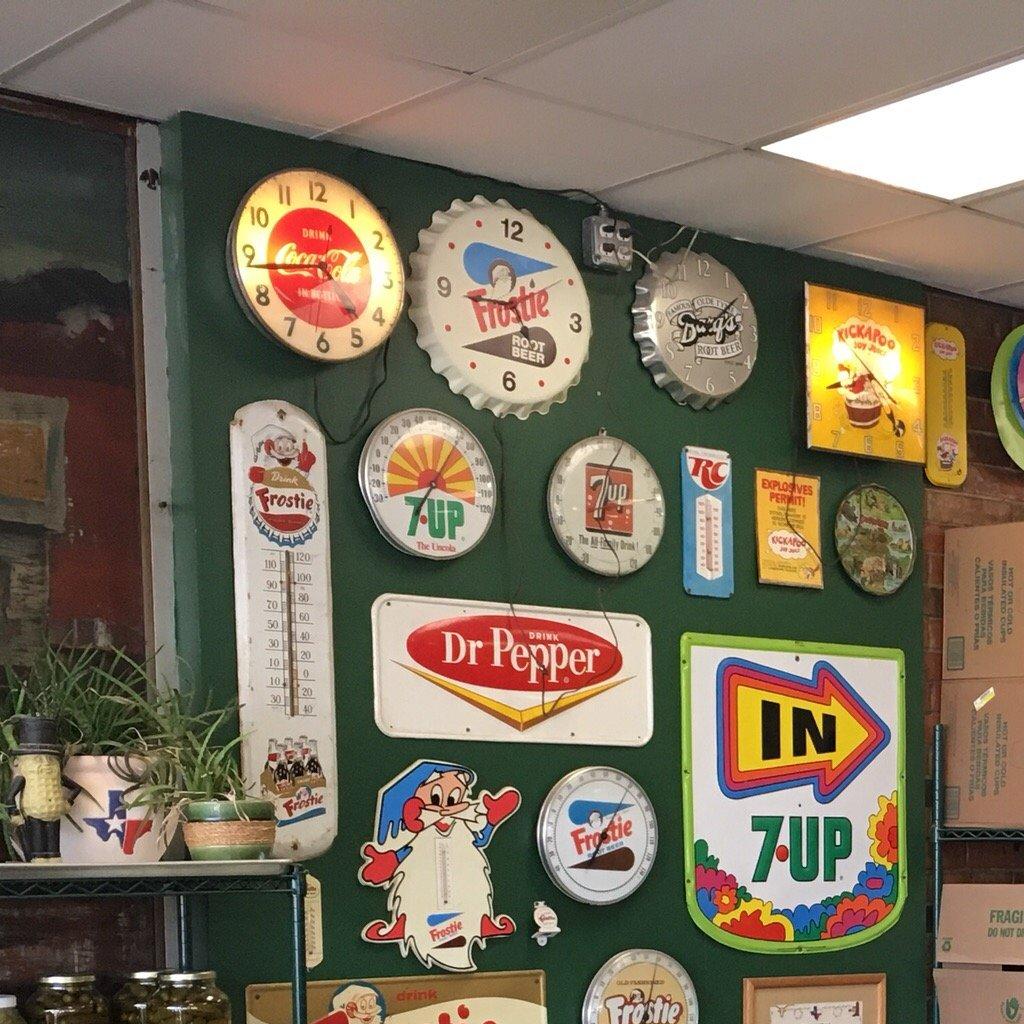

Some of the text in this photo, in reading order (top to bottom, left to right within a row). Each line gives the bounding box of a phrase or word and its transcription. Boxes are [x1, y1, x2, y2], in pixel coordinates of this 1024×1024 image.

[279, 185, 290, 206] 11
[309, 180, 327, 203] 12
[251, 207, 268, 227] 10
[350, 200, 355, 219] 1
[501, 220, 524, 242] 12
[373, 231, 384, 250] 2
[242, 245, 255, 267] 9
[383, 272, 393, 289] 3
[437, 276, 452, 297] 9
[256, 284, 270, 306] 8
[372, 307, 385, 326] 4
[465, 287, 552, 333] Frostie
[283, 316, 296, 337] 7
[569, 312, 582, 334] 3
[317, 332, 330, 353] 6
[351, 328, 363, 348] 5
[511, 334, 545, 352] ROOT
[837, 324, 896, 350] KICKAPOO
[511, 348, 545, 365] BEER
[697, 342, 742, 356] ROOT BEER
[502, 371, 517, 392] 6
[270, 470, 299, 486] Drink
[689, 456, 729, 490] RC
[761, 479, 813, 496] EXPLOSIVES
[255, 487, 314, 513] Frostie
[769, 492, 806, 508] PERMIT!
[416, 541, 430, 551] The
[771, 536, 806, 548] KICKAPOO
[264, 559, 277, 569] 110
[296, 552, 311, 561] 120
[266, 580, 278, 589] 90
[297, 573, 312, 582] 100
[266, 600, 278, 610] 70
[298, 593, 309, 602] 80
[267, 620, 279, 629] 50
[299, 612, 310, 621] 60
[268, 638, 279, 648] 30
[300, 631, 310, 641] 40
[528, 631, 560, 642] DRINK
[269, 658, 279, 667] 10
[300, 651, 311, 660] 20
[441, 627, 601, 684] Dr Pepper
[270, 677, 281, 686] 10
[303, 670, 309, 679] 0
[270, 695, 281, 704] 30
[302, 687, 313, 697] 20
[303, 705, 313, 714] 40
[761, 699, 837, 761] IN
[282, 794, 324, 818] Frostie
[570, 815, 633, 856] Frostie
[428, 919, 463, 942] Frostie
[987, 928, 998, 938] DO
[1000, 927, 1015, 938] NOT
[396, 988, 438, 1002] drink
